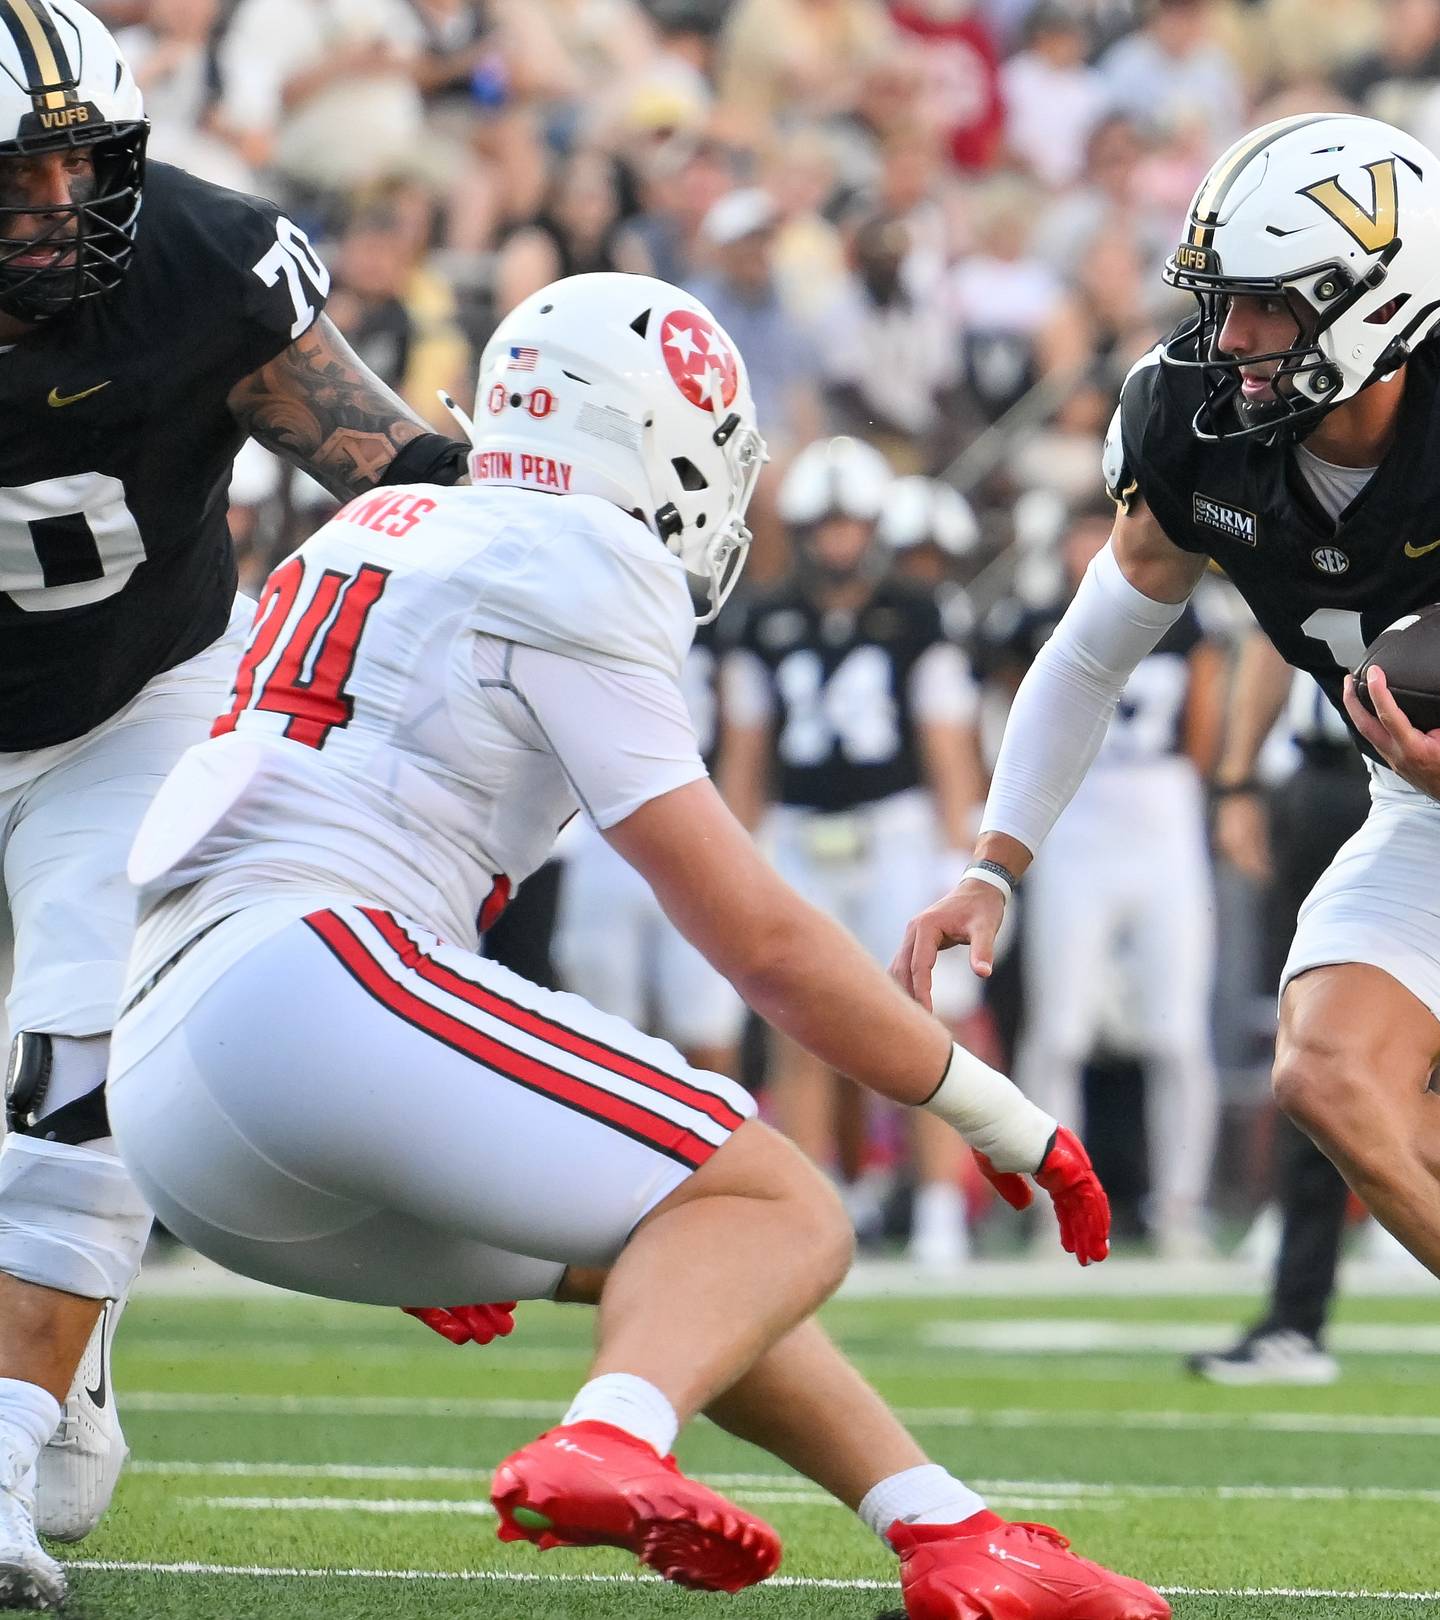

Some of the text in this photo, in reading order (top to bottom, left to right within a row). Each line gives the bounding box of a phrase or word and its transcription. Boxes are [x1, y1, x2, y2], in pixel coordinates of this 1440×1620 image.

[40, 106, 89, 129] VUFB
[1295, 157, 1399, 256] V
[251, 215, 331, 340] 70
[519, 453, 573, 491] PEAY
[1206, 502, 1254, 535] SRM
[1315, 549, 1346, 573] SEC
[777, 645, 899, 766] 14
